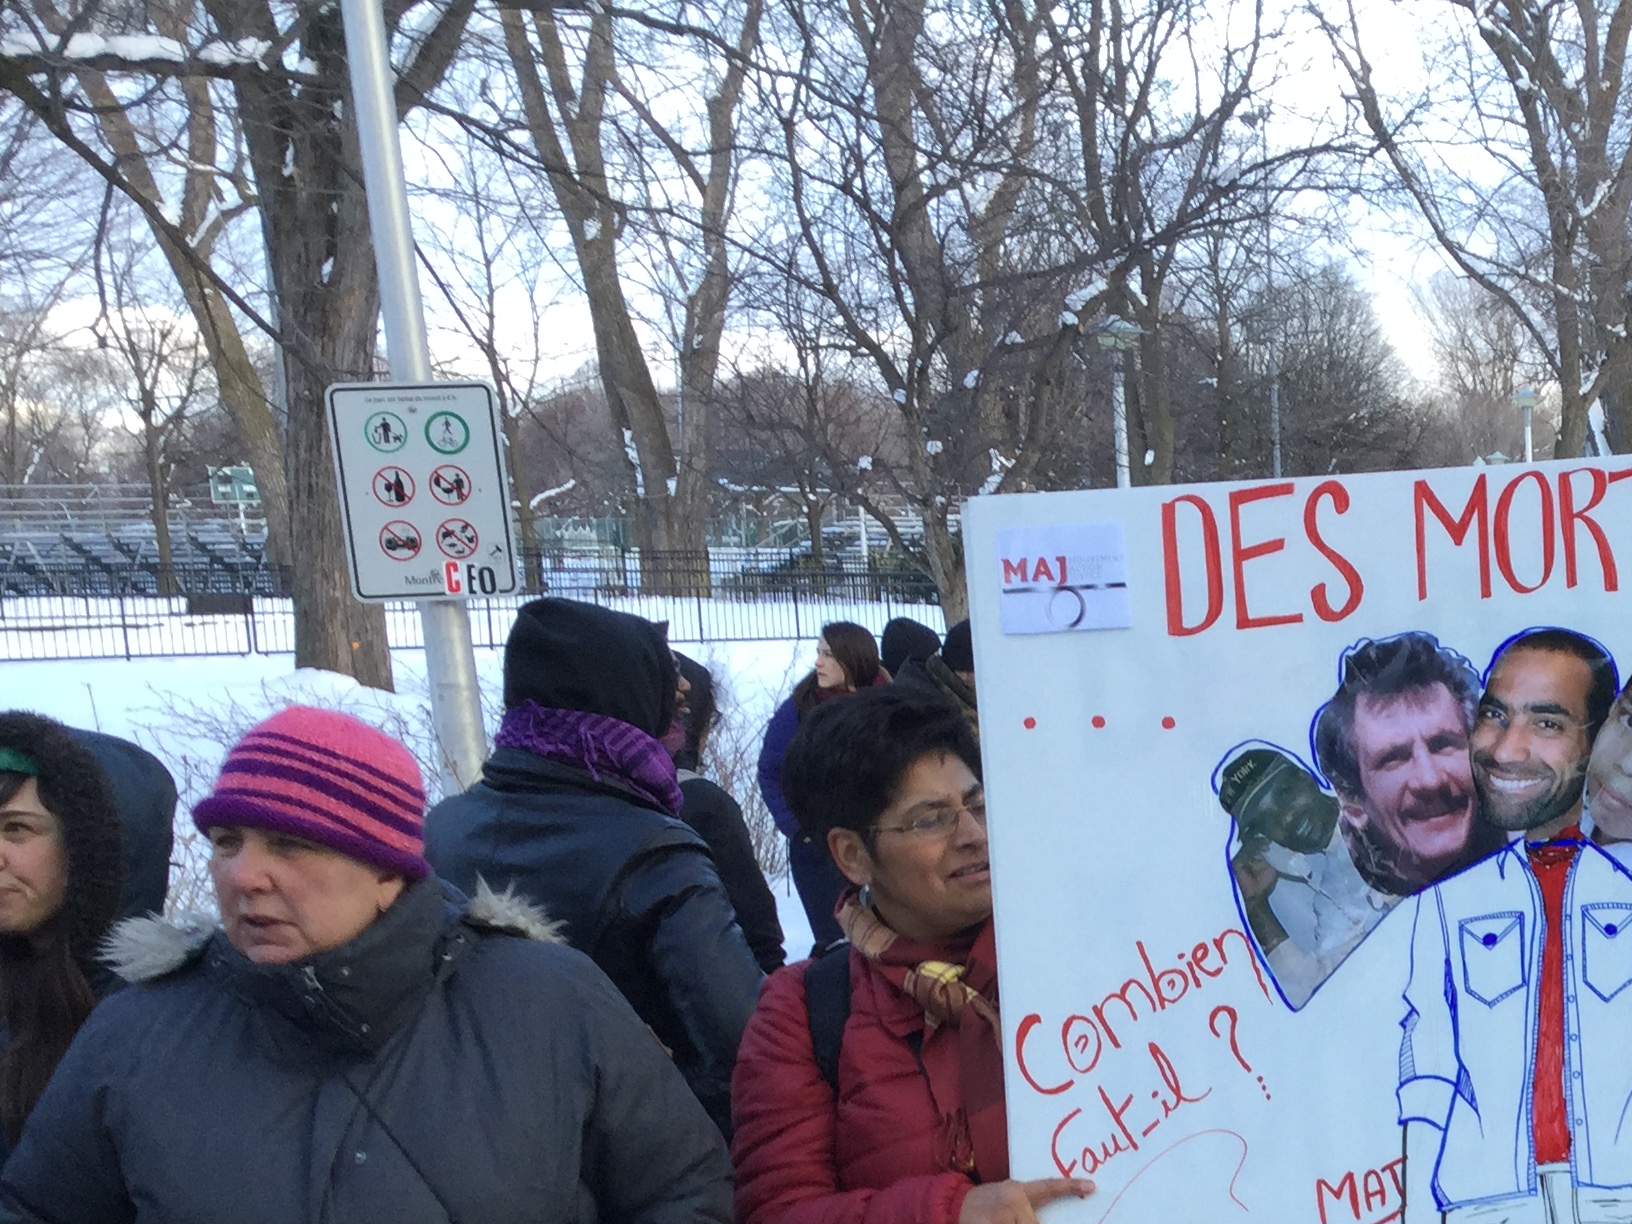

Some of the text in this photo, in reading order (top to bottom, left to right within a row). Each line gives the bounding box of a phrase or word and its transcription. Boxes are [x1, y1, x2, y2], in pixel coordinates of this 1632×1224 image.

[1001, 555, 1068, 586] MAJ
[1161, 481, 1365, 638] DES
[1015, 928, 1273, 1096] Combien
